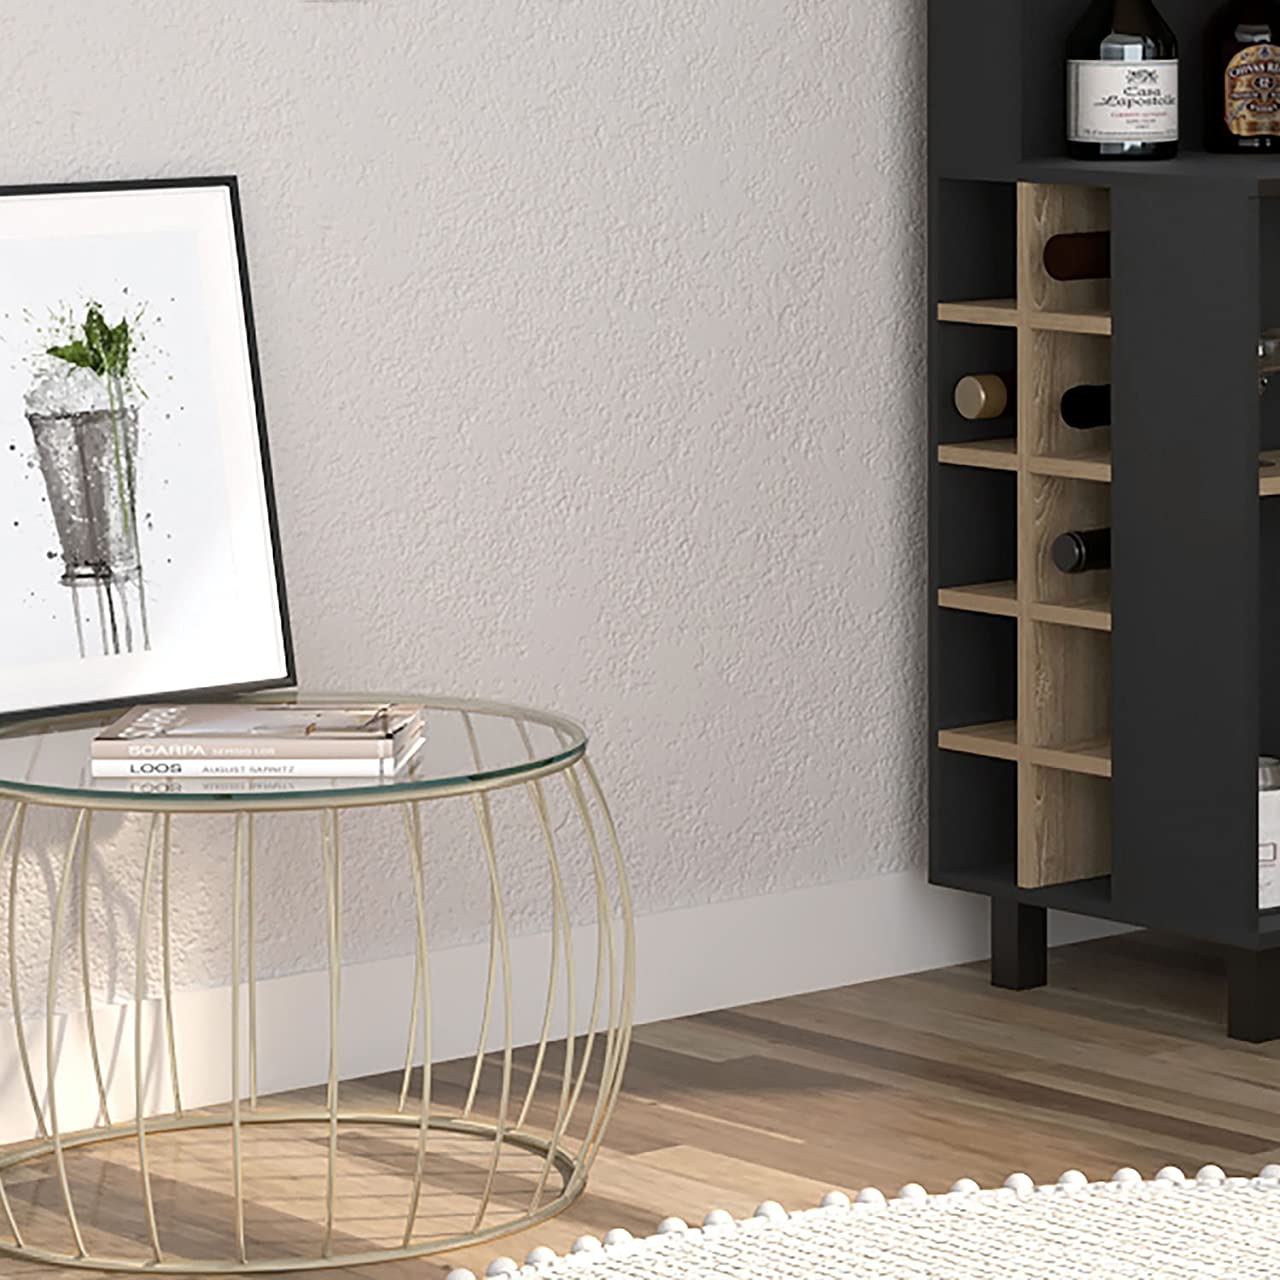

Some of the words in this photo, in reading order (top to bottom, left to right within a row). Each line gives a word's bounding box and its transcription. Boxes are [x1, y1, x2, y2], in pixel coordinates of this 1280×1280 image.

[1123, 86, 1161, 97] Casa
[128, 745, 206, 756] SCARPA
[130, 763, 182, 774] LOOS
